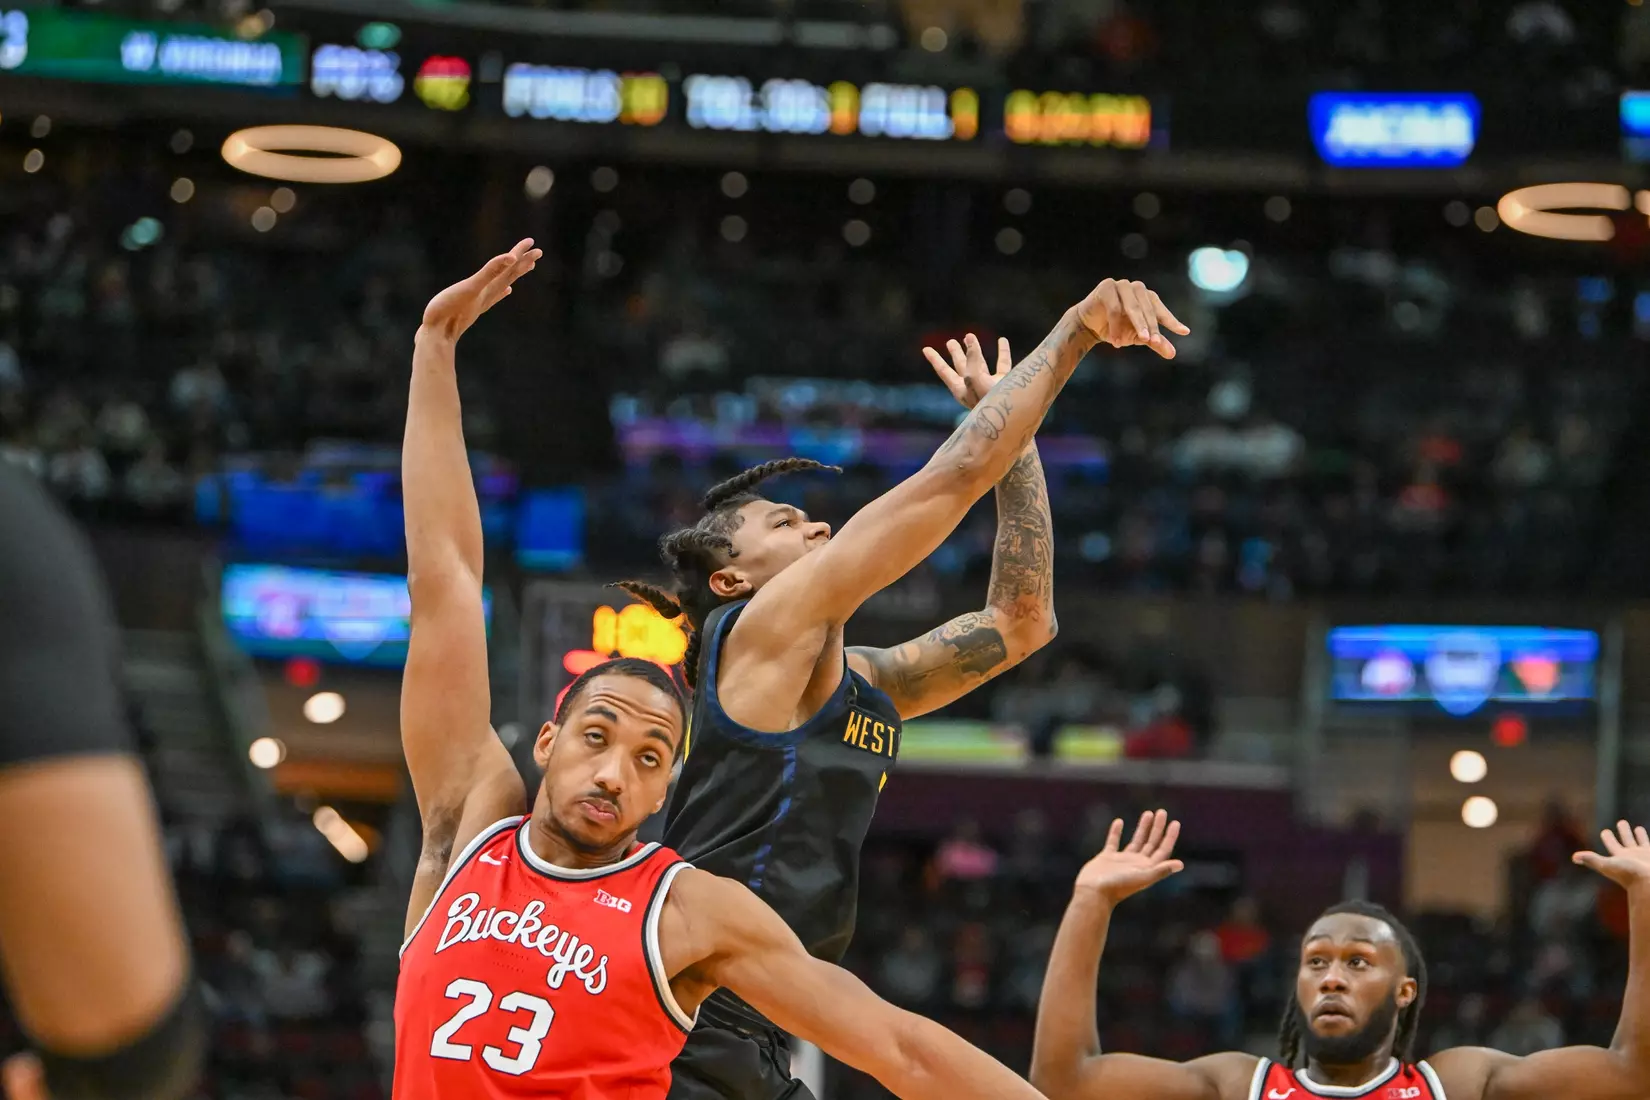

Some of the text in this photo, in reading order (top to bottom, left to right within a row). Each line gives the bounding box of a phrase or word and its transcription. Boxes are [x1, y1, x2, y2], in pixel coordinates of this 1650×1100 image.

[843, 711, 895, 757] WEST
[434, 892, 609, 995] Buckeyes
[429, 977, 556, 1076] 23
